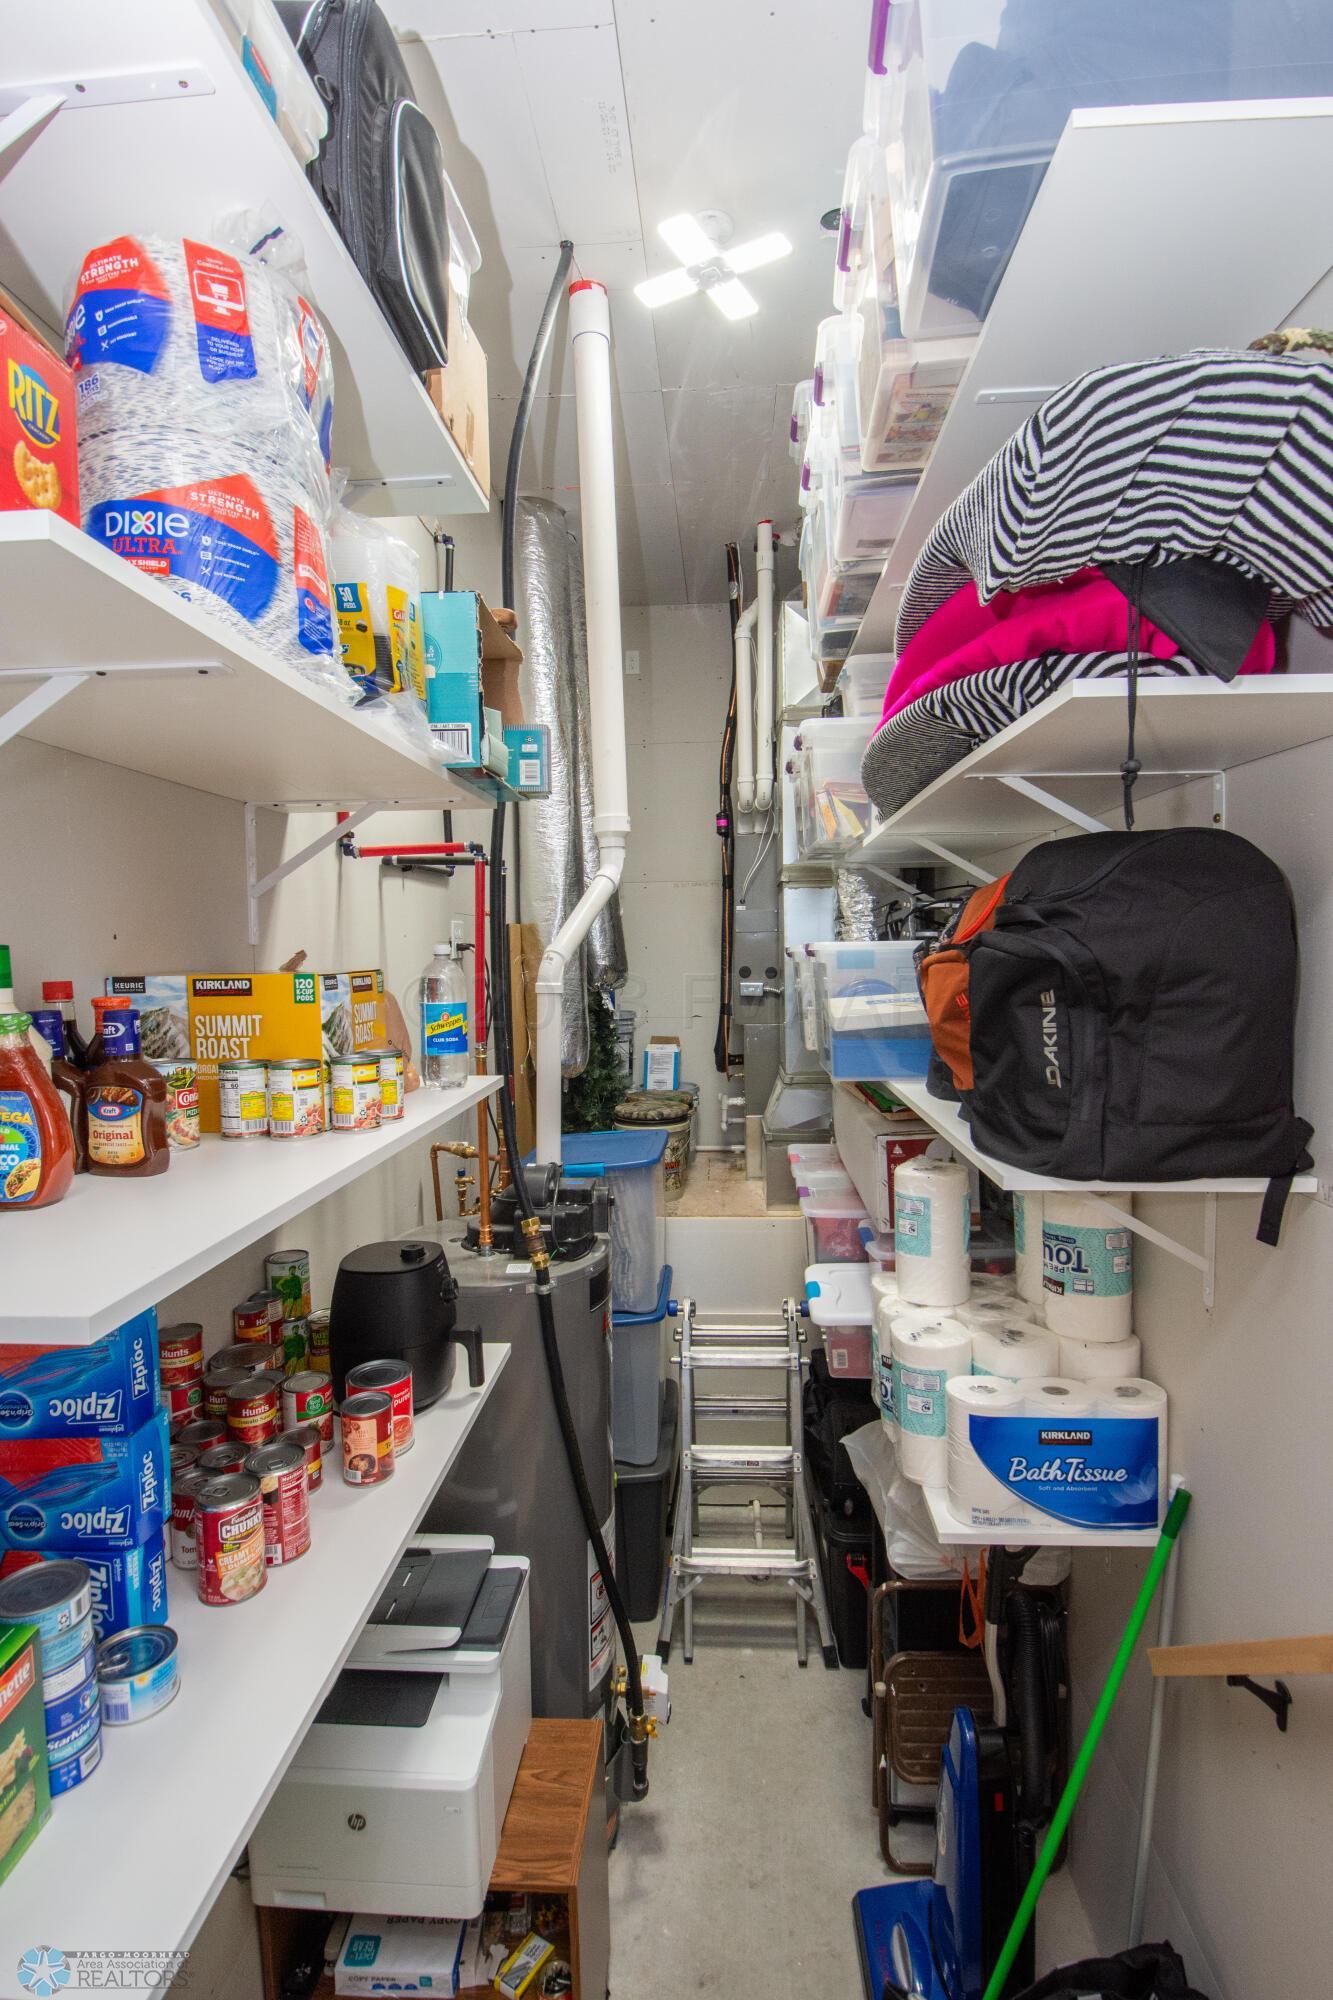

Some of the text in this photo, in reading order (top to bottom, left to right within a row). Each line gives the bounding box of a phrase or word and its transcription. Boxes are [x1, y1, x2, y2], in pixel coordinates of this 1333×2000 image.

[80, 258, 140, 284] STRENGTH
[79, 374, 99, 394] 186
[8, 357, 61, 442] RITZ
[190, 492, 260, 520] STRENGTH
[208, 490, 246, 505] ULTIMATE
[112, 536, 177, 555] ULTRA
[138, 560, 167, 568] SHIELD
[195, 980, 250, 990] KIRKLAND
[295, 979, 314, 989] 120
[354, 1001, 377, 1024] SUMMIT
[103, 1026, 116, 1035] aft
[195, 1014, 262, 1037] SUMMIT
[355, 1022, 374, 1044] ROAST
[430, 1017, 463, 1034] Schweppes
[196, 1037, 250, 1059] ROAST
[1041, 989, 1062, 1089] DAKINE
[0, 1111, 33, 1125] TEGA
[93, 1131, 134, 1142] Original
[0, 1154, 20, 1166] CO
[133, 1337, 148, 1396] Ziploc
[49, 1391, 116, 1420] Ziploc
[1041, 1431, 1091, 1440] KIRKLAND
[142, 1450, 158, 1509] Ziploc
[1008, 1456, 1128, 1482] Bath Tissue
[61, 1506, 125, 1534] Ziploc
[222, 1512, 262, 1539] CHUNKY
[149, 1554, 163, 1612] Ziploc
[47, 1719, 91, 1750] StarKist
[350, 1813, 365, 1830] hp
